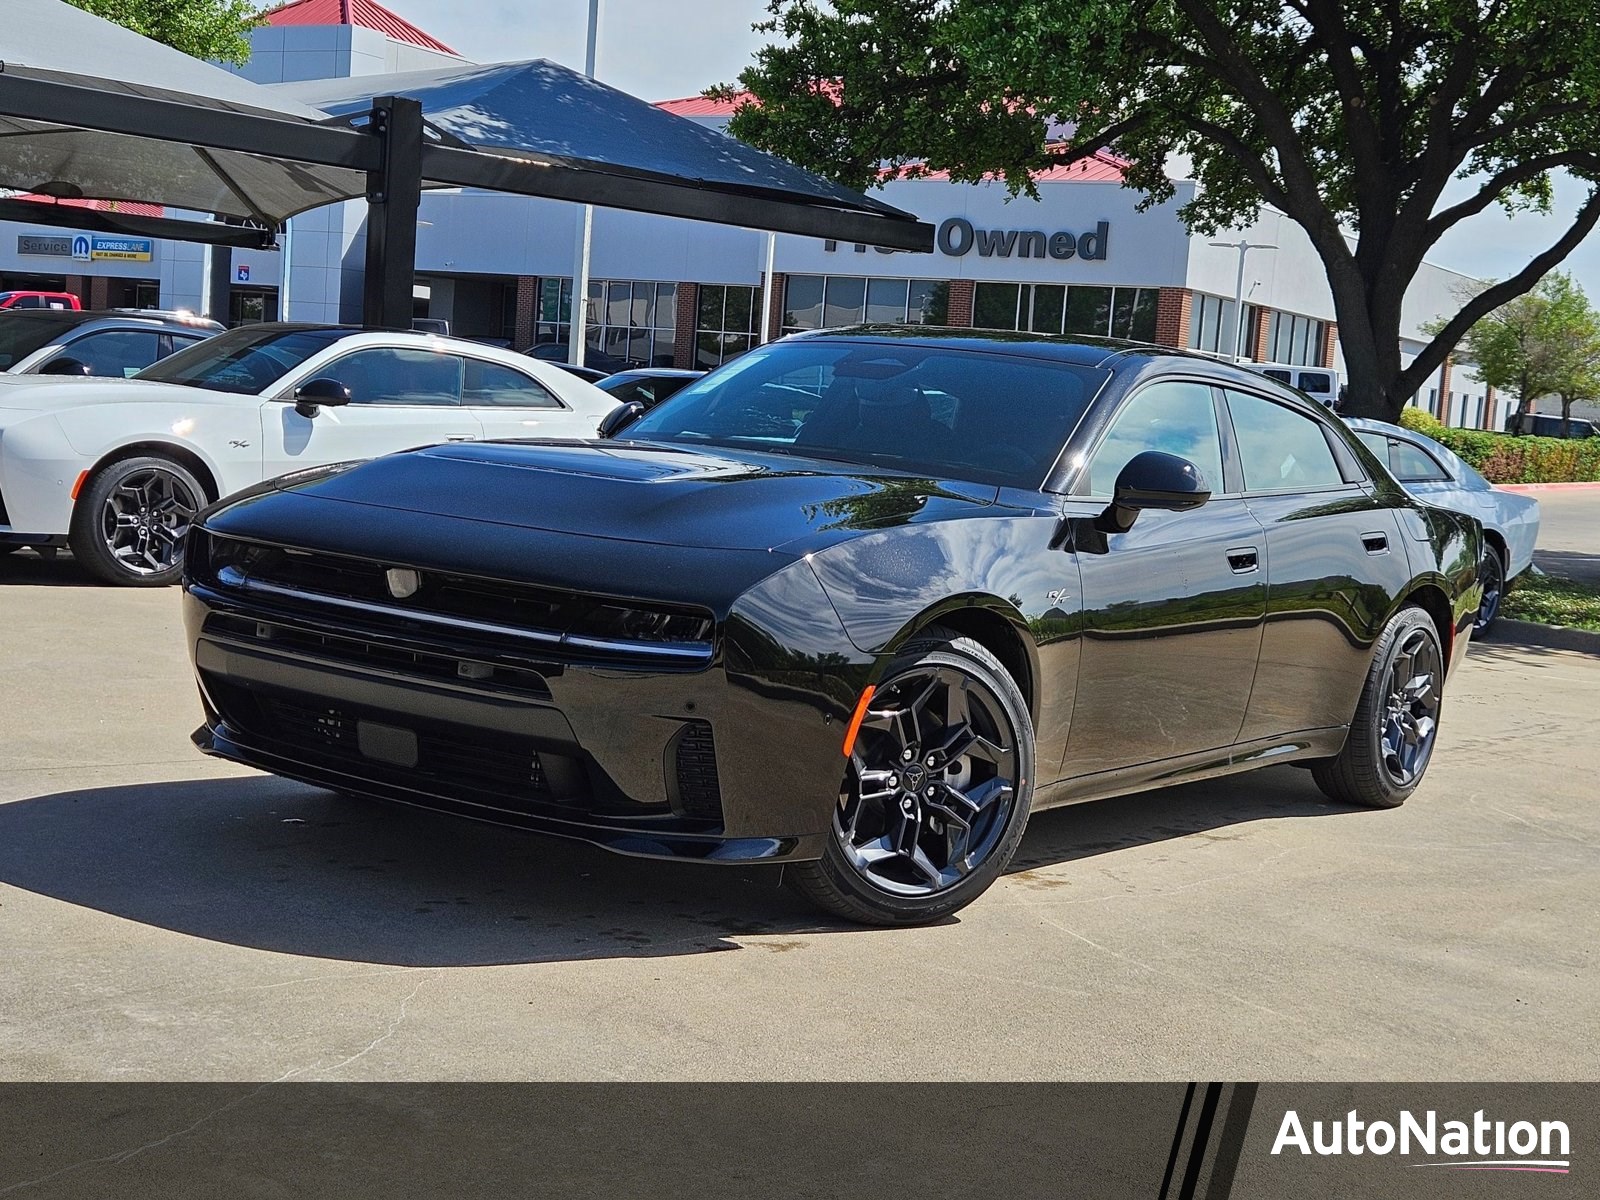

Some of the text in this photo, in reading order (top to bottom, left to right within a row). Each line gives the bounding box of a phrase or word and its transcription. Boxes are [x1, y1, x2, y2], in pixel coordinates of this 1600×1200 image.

[23, 239, 68, 252] Service
[1046, 588, 1071, 606] R/T
[961, 646, 988, 664] OUTSIDE
